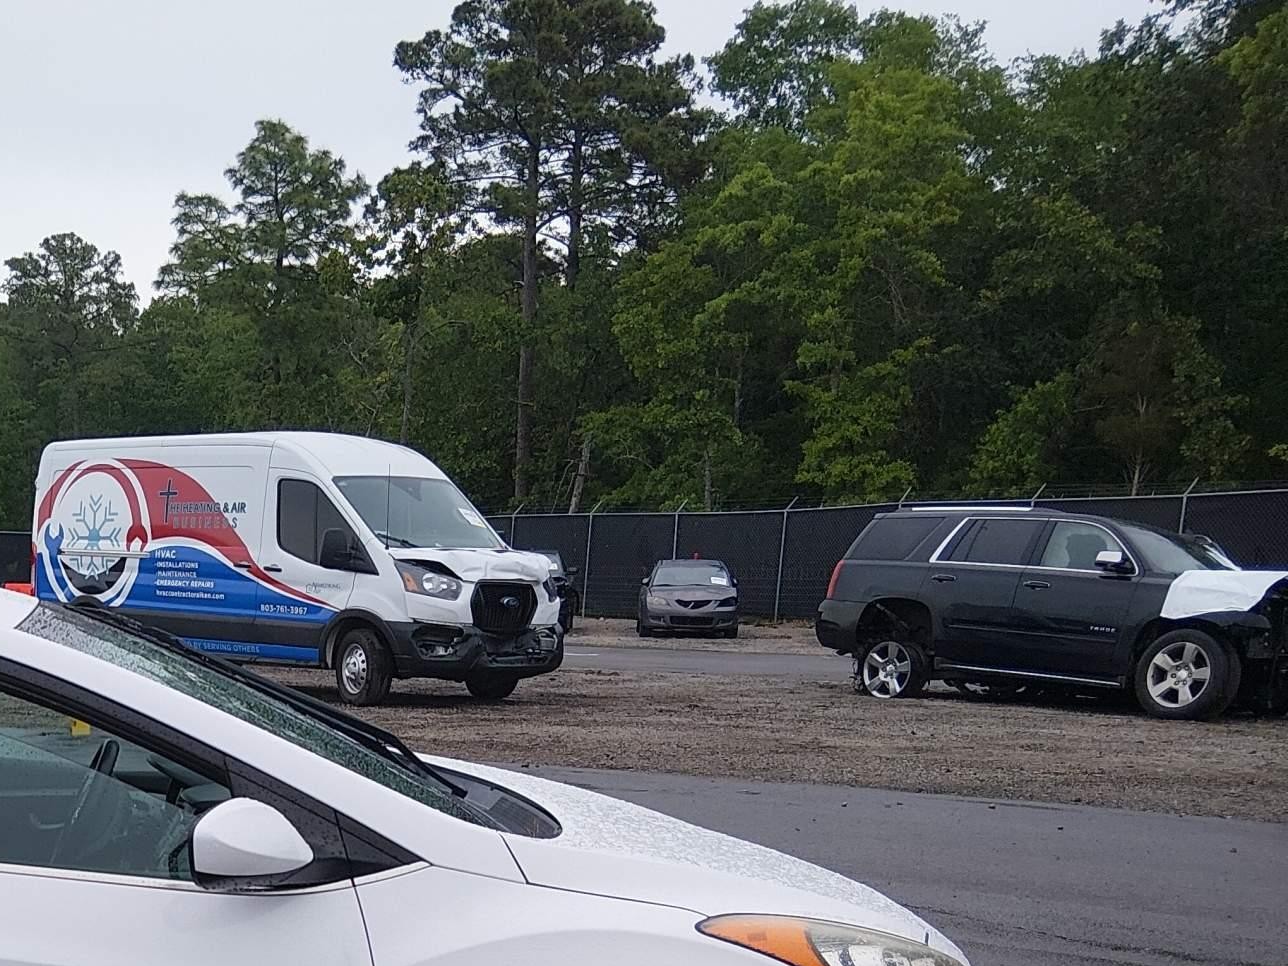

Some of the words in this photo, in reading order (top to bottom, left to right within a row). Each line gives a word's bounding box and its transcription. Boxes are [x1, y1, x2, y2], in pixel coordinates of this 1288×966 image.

[183, 501, 221, 513] HEATING
[222, 502, 230, 513] &
[230, 502, 246, 513] AIR
[173, 516, 238, 529] BUSINESS
[155, 550, 176, 559] HVAC
[260, 604, 308, 616] 803-761-3967
[203, 641, 232, 651] SERVING
[233, 644, 260, 653] OTHERS
